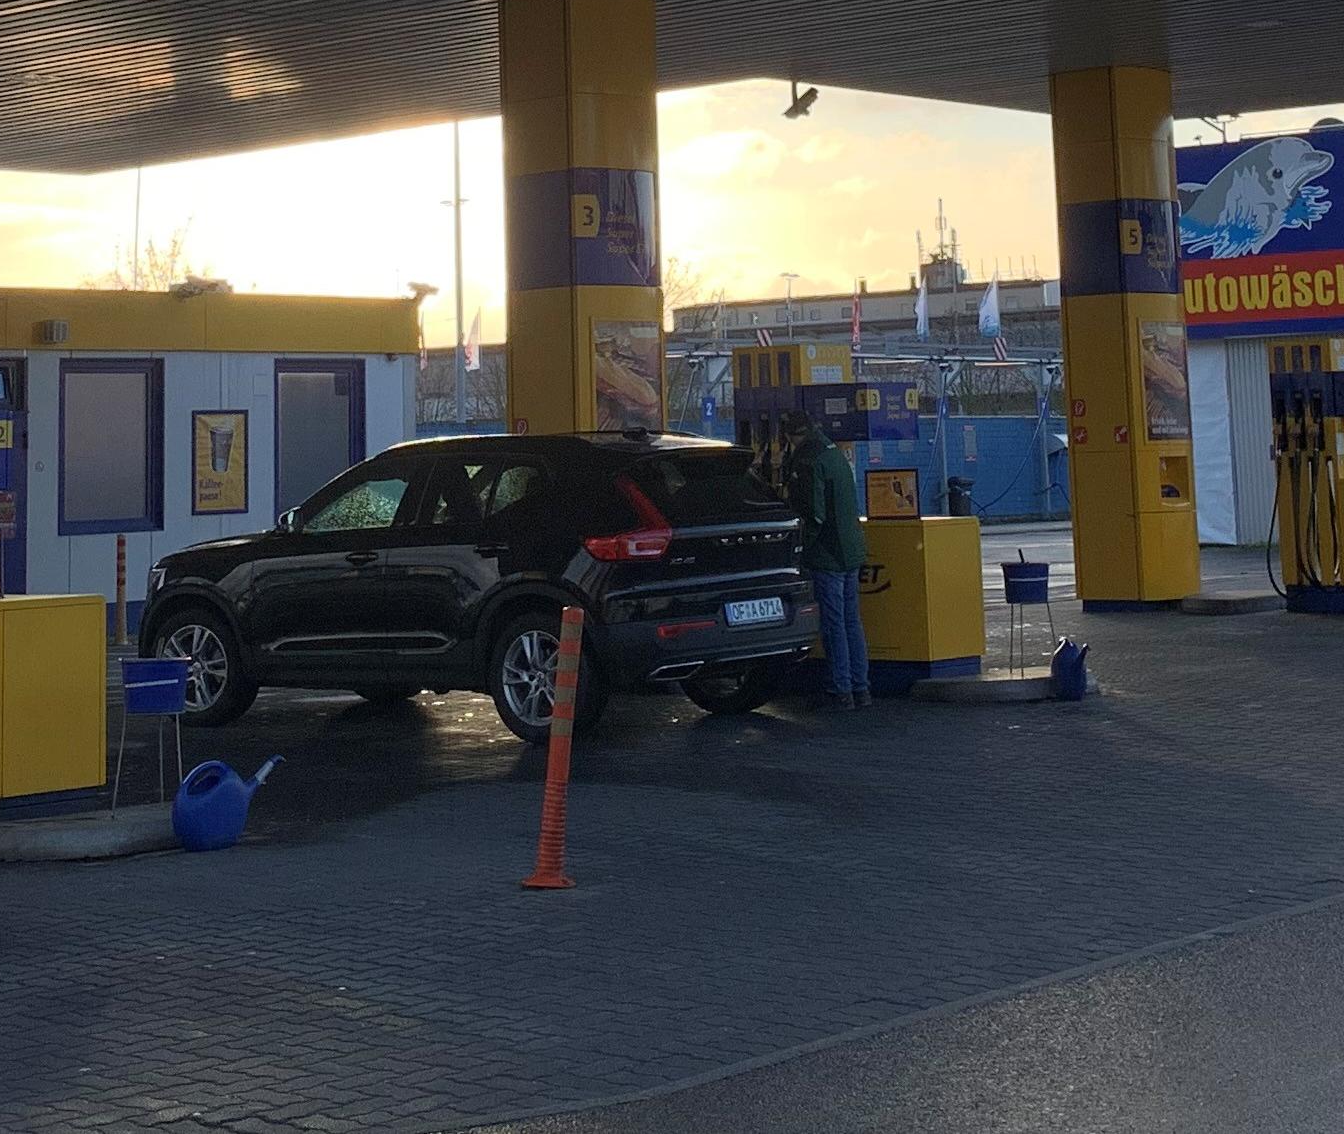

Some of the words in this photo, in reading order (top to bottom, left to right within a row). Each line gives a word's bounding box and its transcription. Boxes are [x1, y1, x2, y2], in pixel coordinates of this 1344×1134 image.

[582, 205, 594, 226] 3
[1129, 229, 1138, 246] 5
[706, 402, 713, 416] 2
[858, 563, 885, 584] ET
